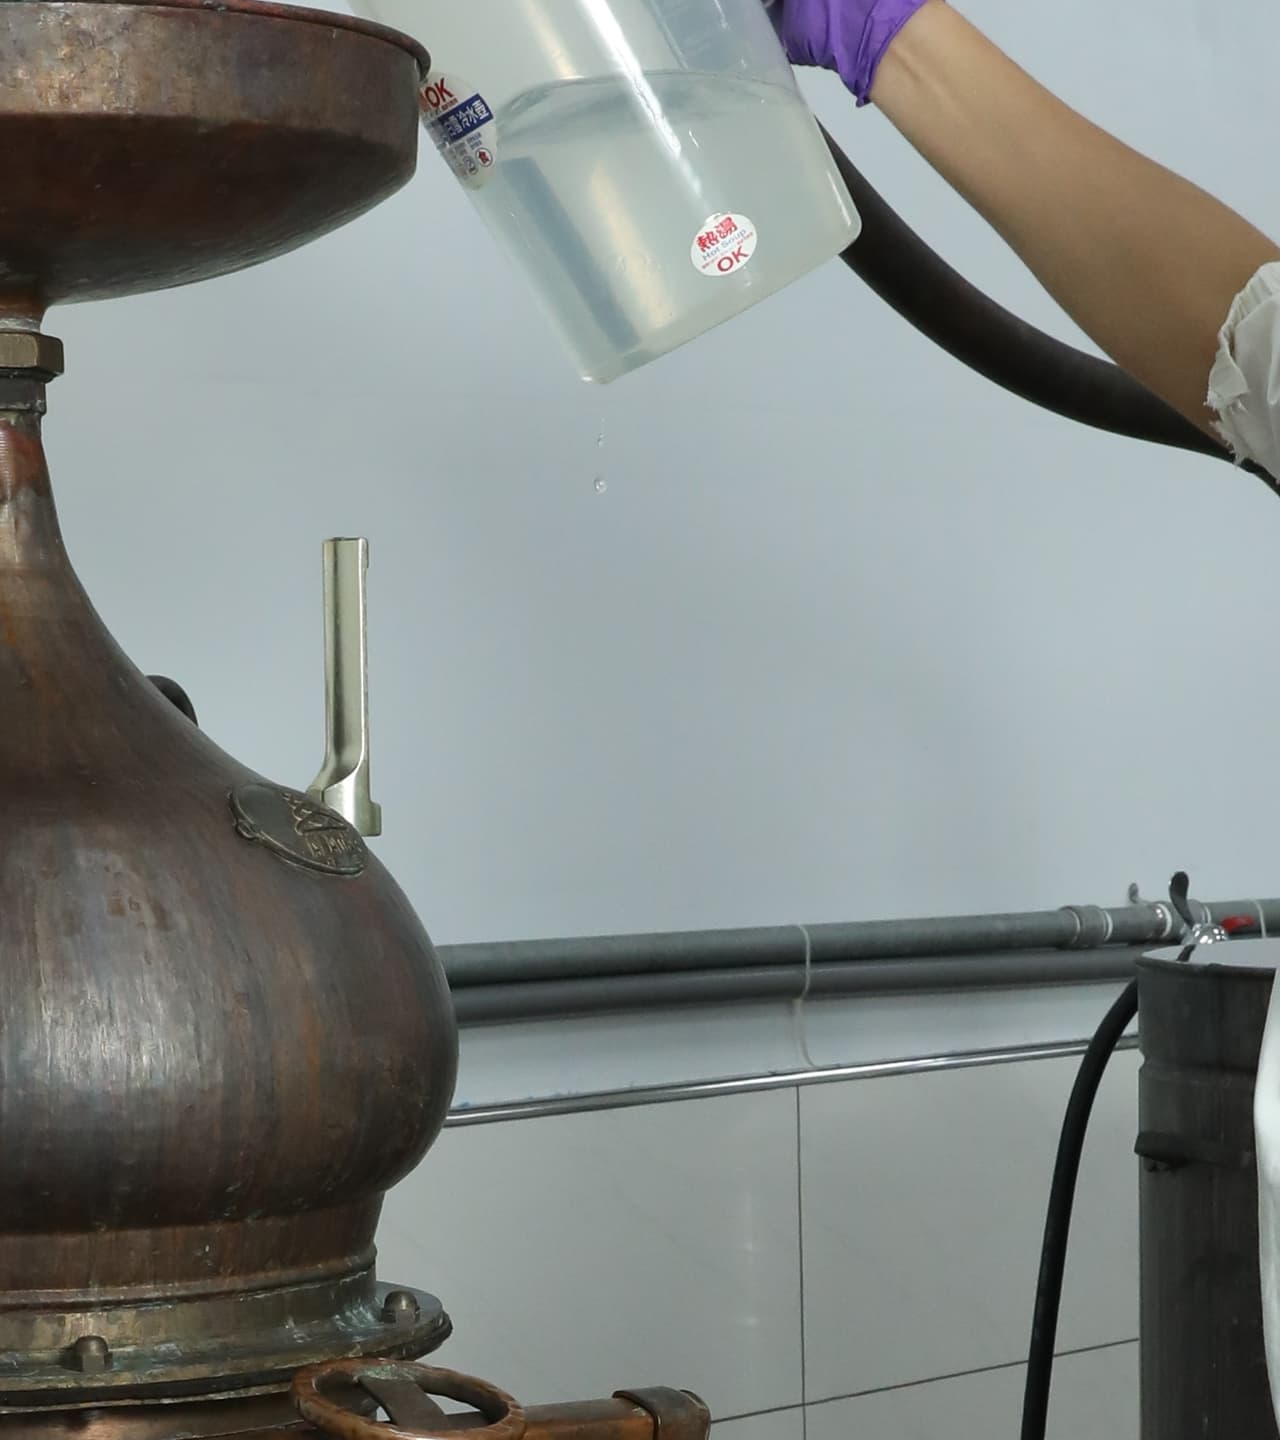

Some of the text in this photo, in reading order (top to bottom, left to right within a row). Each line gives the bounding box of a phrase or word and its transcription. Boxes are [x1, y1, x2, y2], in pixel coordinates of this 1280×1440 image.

[702, 246, 720, 261] Hot
[720, 228, 746, 248] Soup
[717, 245, 749, 272] OK
